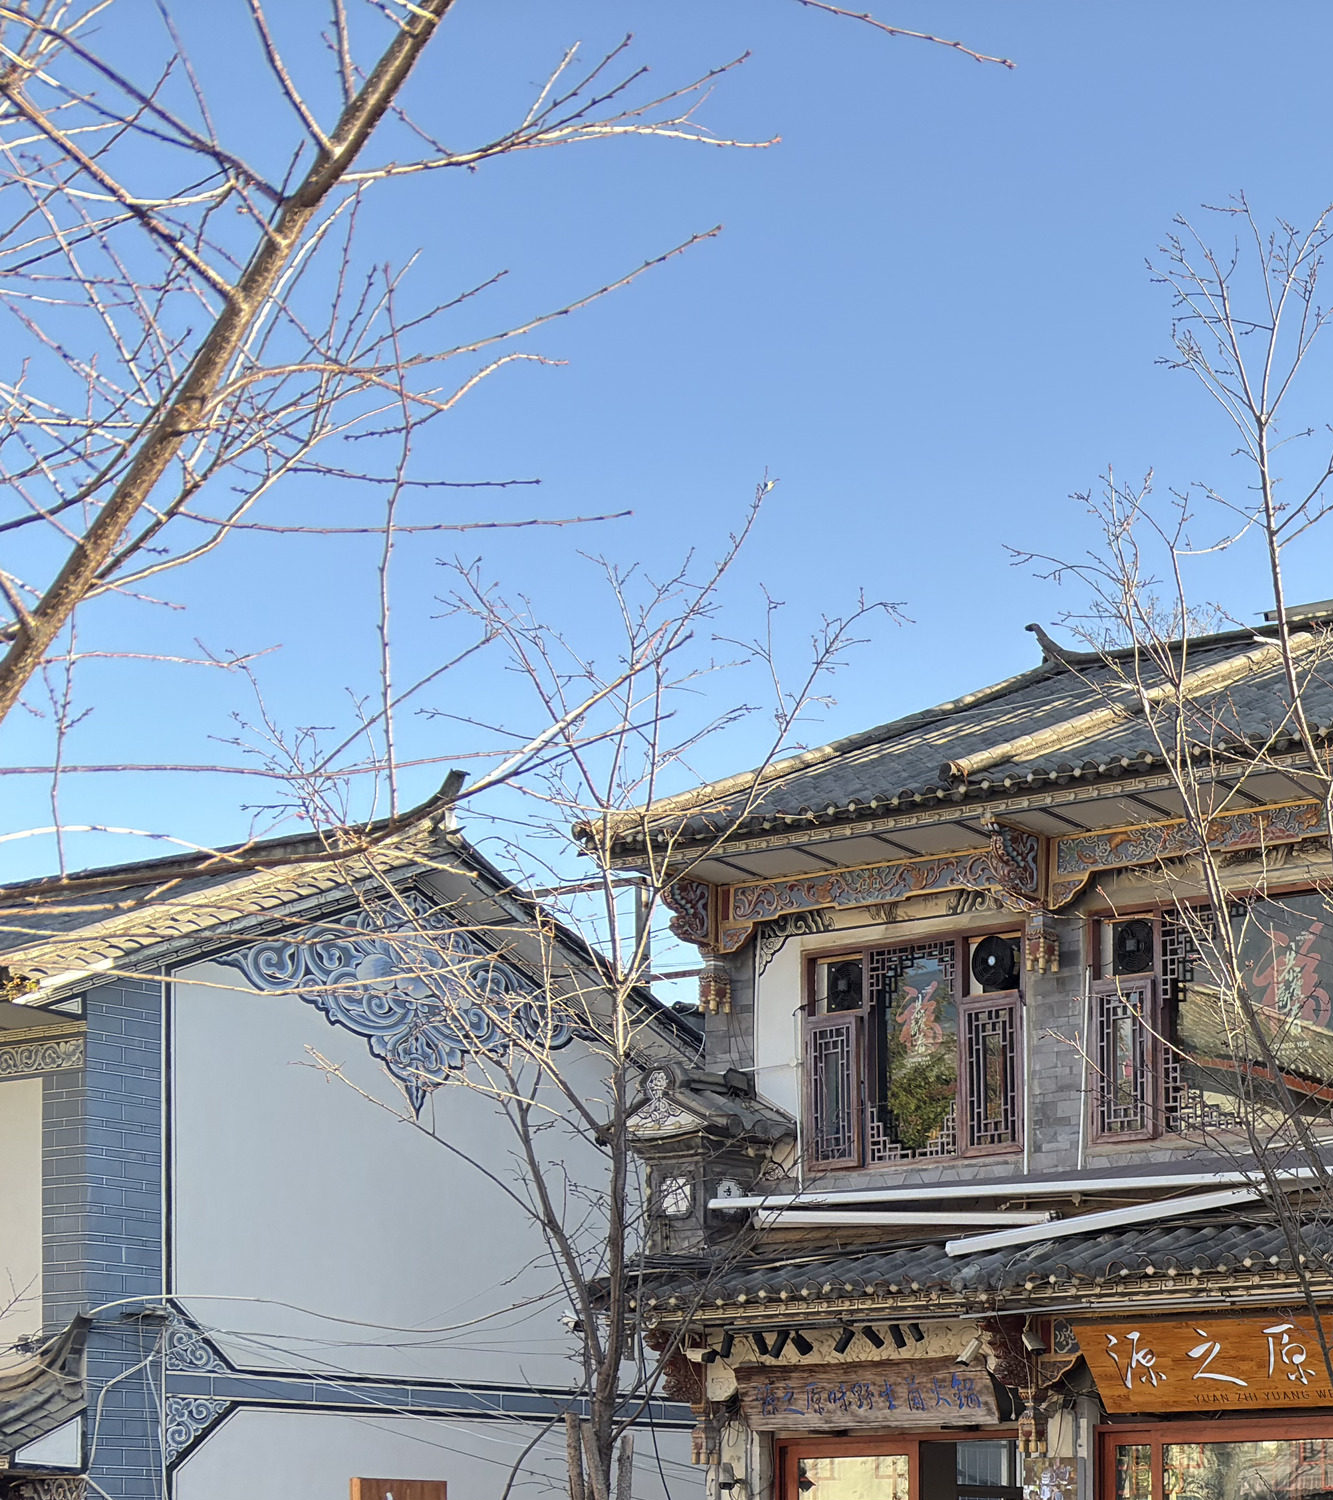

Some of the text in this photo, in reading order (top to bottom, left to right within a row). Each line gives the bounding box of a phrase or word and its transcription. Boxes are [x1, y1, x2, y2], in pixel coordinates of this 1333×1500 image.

[756, 1371, 982, 1417] 源之原味野生菌火锅
[1193, 1392, 1230, 1404] YUAN
[1235, 1391, 1259, 1402] ZHI
[1262, 1389, 1311, 1401] YUANG
